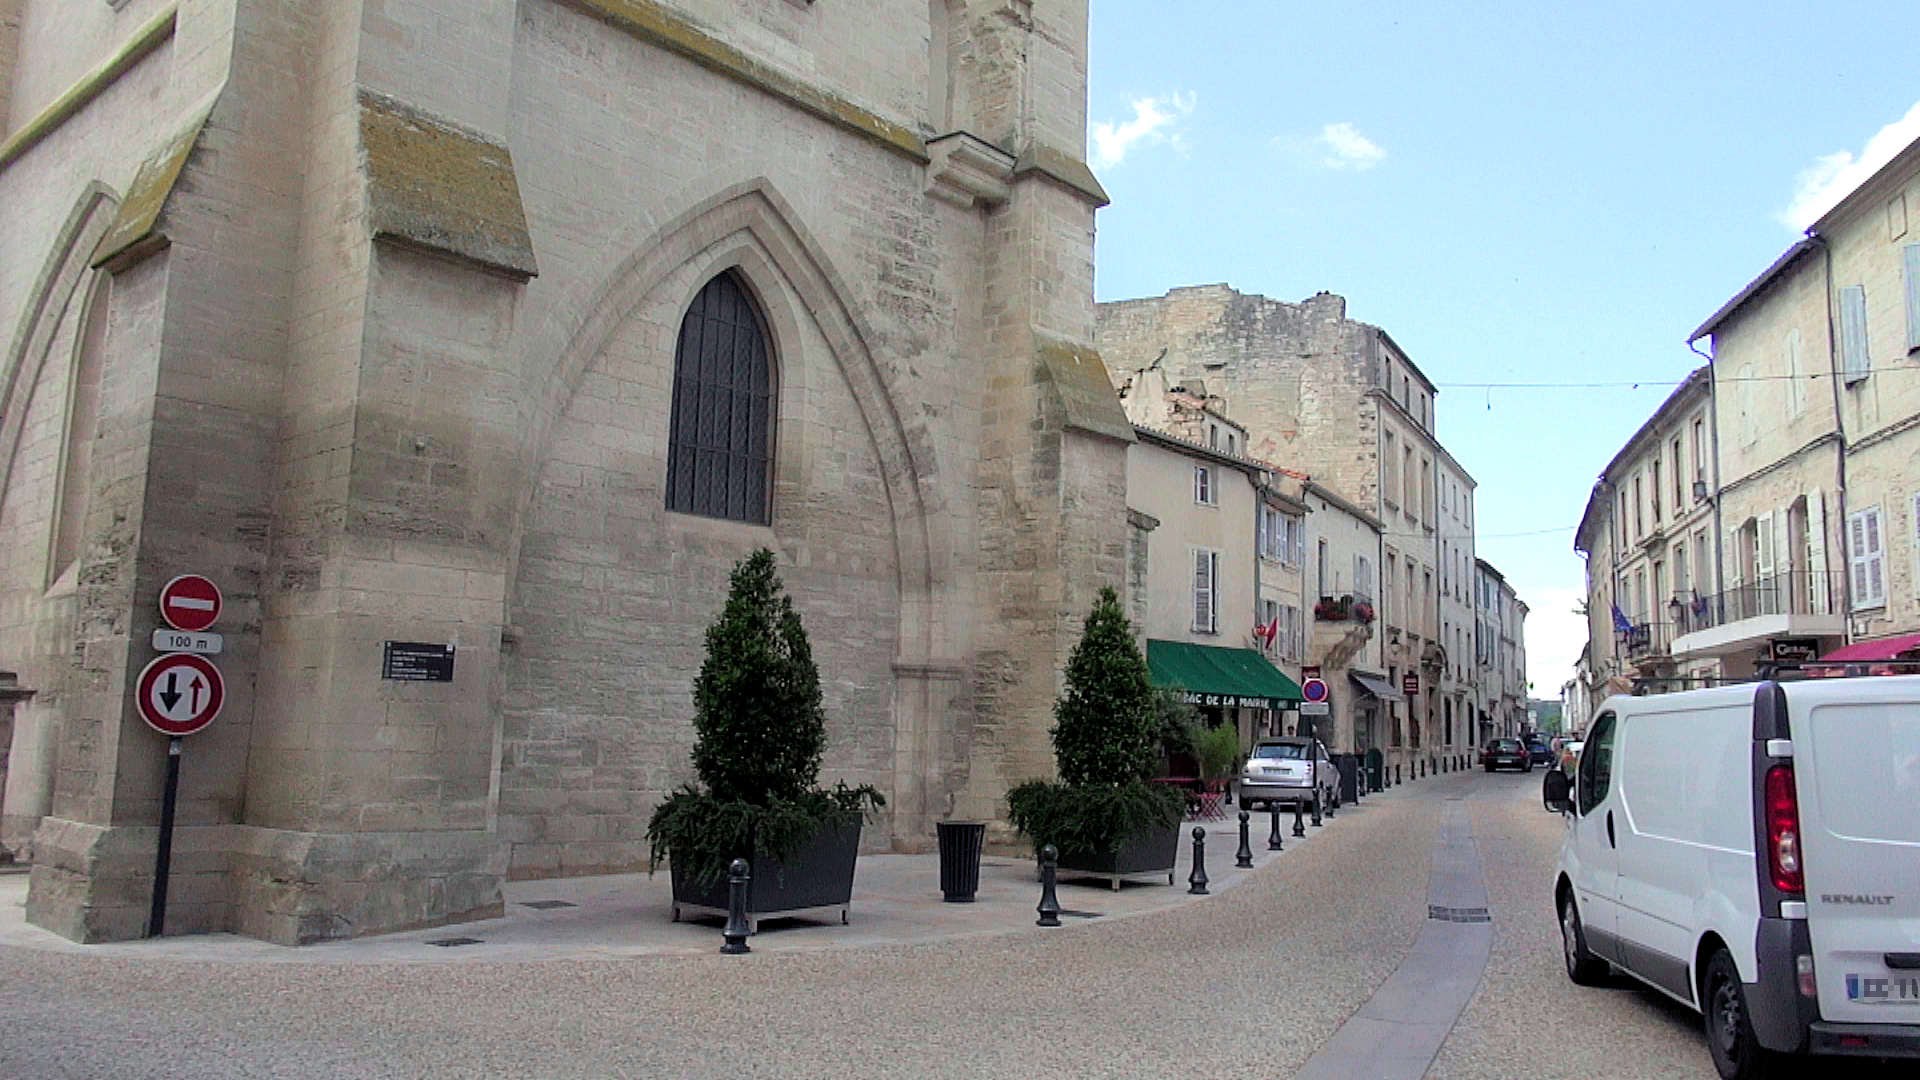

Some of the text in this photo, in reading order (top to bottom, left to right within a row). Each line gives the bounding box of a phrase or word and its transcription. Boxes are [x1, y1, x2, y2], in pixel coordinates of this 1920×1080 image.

[170, 636, 207, 649] 100 m
[1206, 694, 1219, 706] DE
[1223, 695, 1235, 706] LA
[1239, 697, 1270, 710] MAIRIE
[1821, 894, 1895, 905] RENAULT
